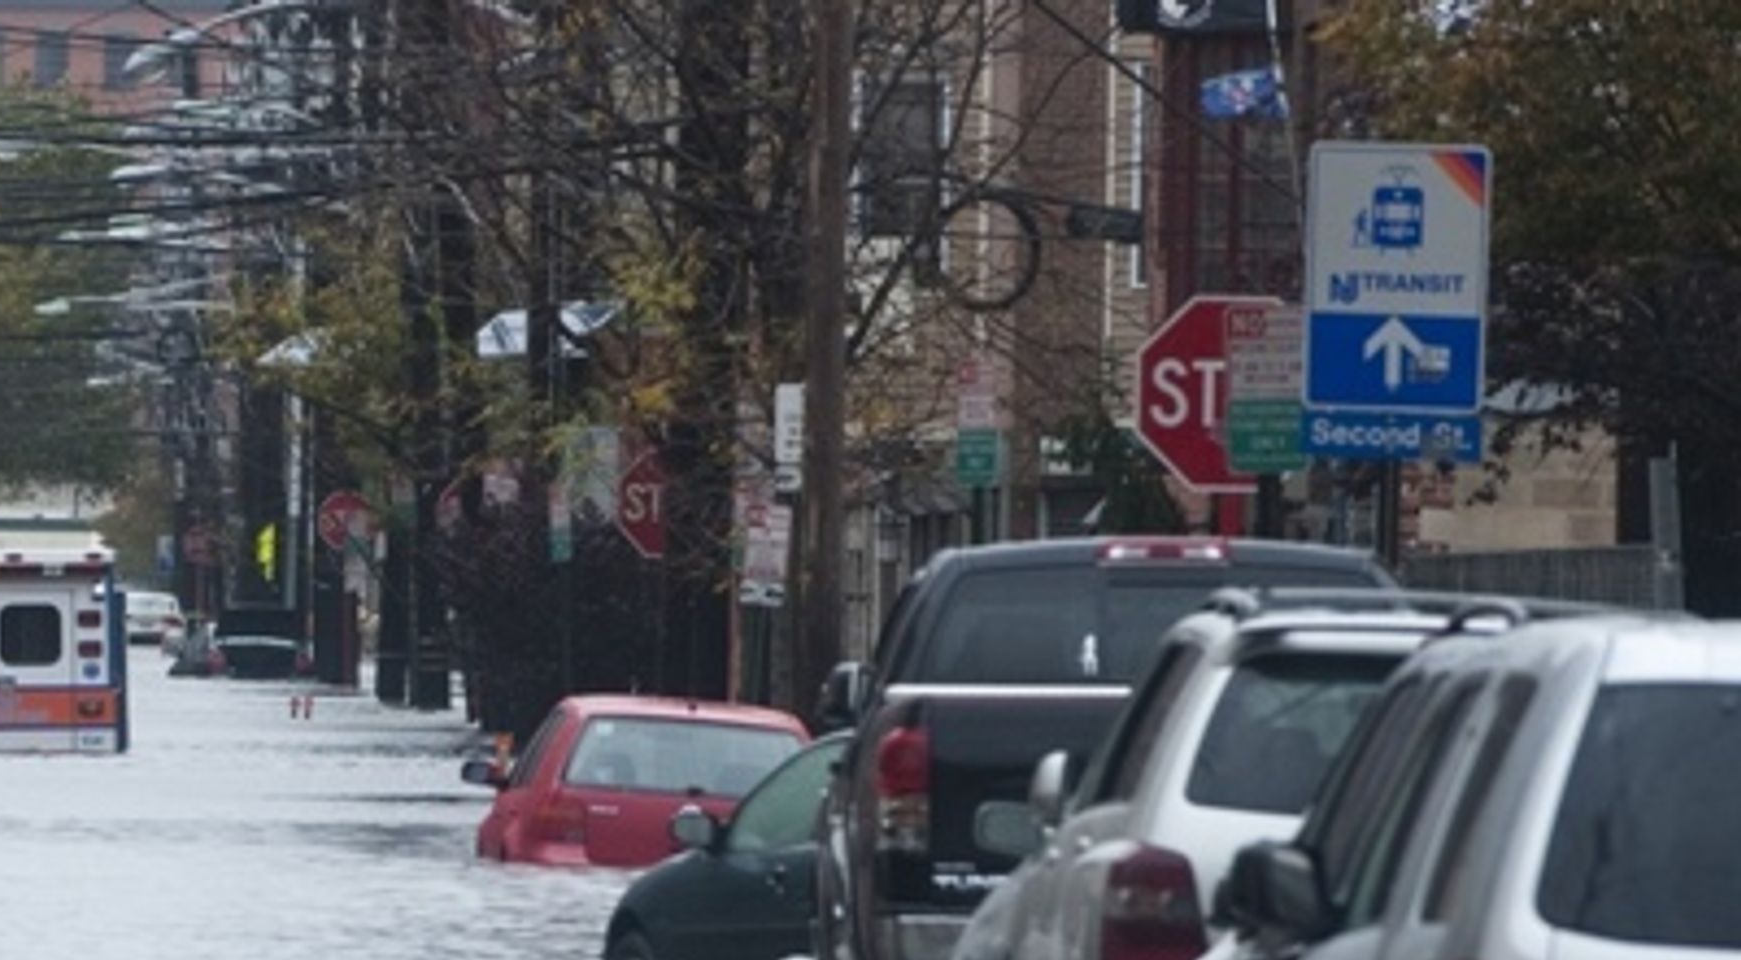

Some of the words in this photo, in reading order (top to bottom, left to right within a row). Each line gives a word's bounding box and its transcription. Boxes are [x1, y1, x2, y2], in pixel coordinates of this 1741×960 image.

[1363, 274, 1465, 293] TRANSIT
[1231, 311, 1265, 336] NO
[1148, 357, 1225, 428] ST
[1310, 418, 1421, 448] Second
[625, 483, 662, 523] ST
